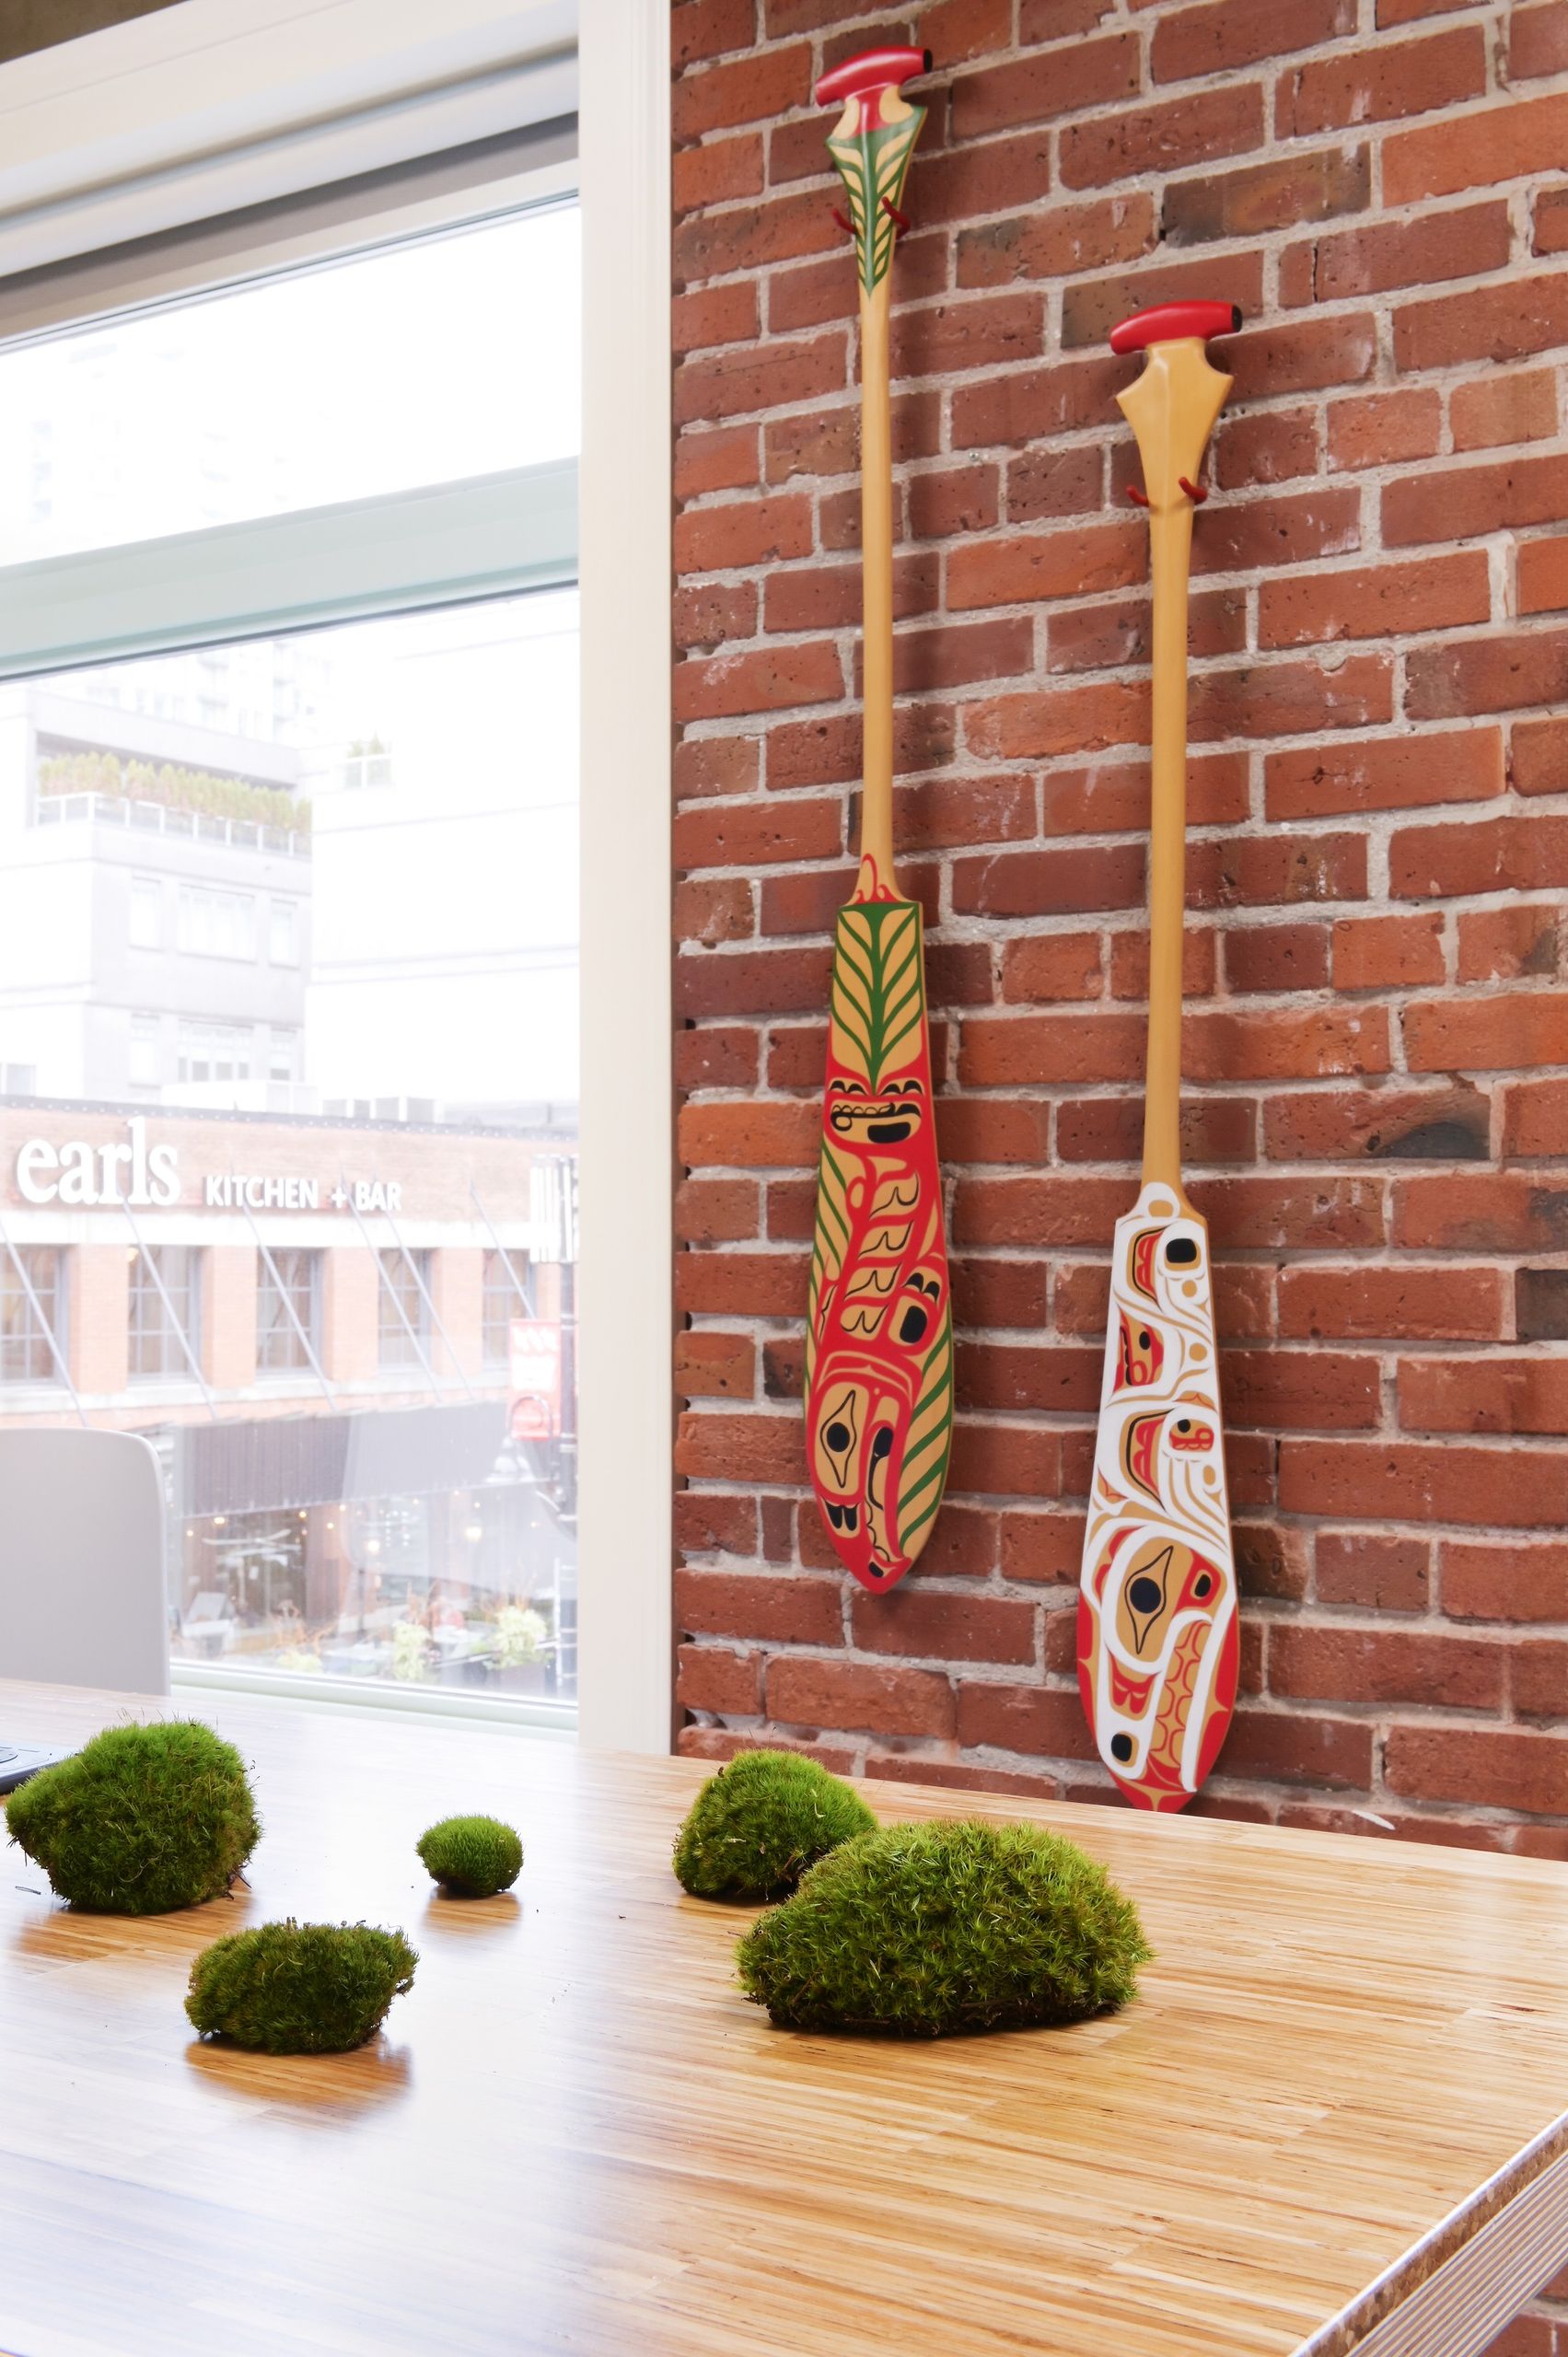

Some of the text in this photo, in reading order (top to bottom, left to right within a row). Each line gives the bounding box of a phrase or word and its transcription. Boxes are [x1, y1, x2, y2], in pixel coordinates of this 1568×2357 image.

[17, 1116, 181, 1205] earls
[206, 1175, 319, 1209] KITCHEN
[355, 1180, 402, 1211] BAR
